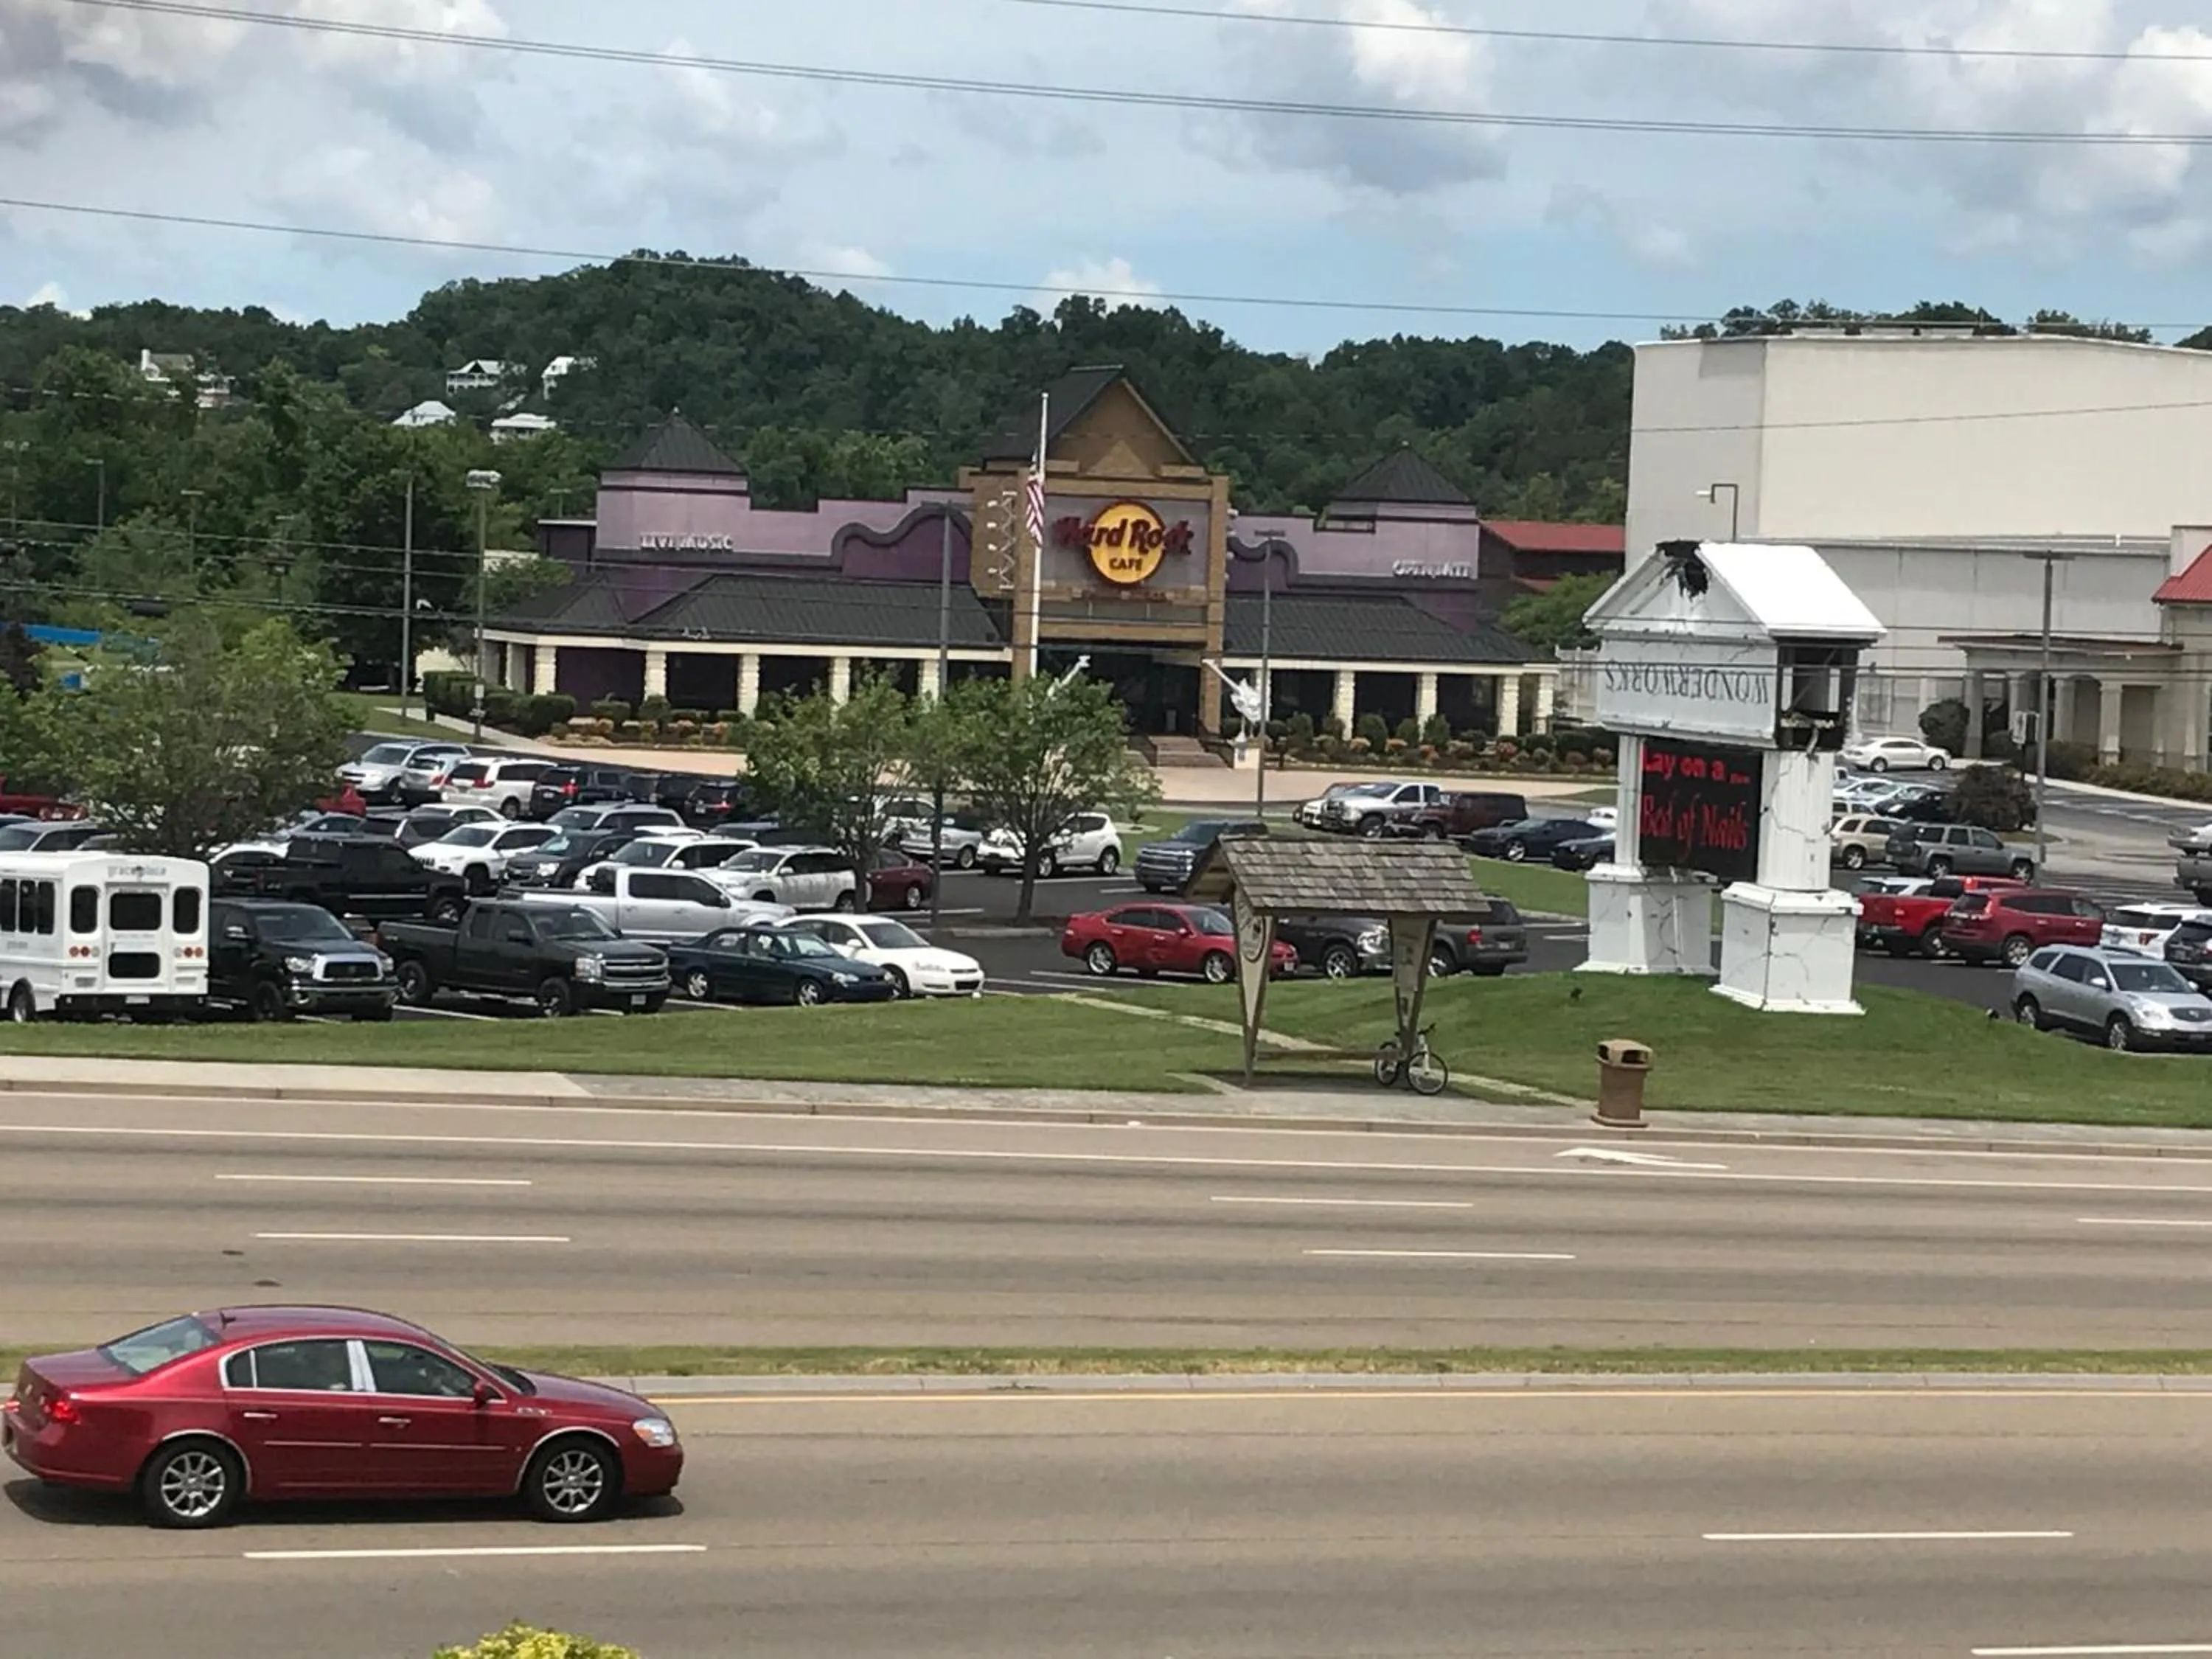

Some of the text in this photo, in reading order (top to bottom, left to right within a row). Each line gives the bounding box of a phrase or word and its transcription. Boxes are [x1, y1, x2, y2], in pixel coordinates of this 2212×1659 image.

[1053, 516, 1194, 554] Hard Rock
[1109, 557, 1143, 571] CAFE
[1605, 661, 1769, 704] WONDERWORKS
[1641, 745, 1676, 781] Lay
[1680, 757, 1706, 778] on
[1700, 801, 1749, 851] Nails
